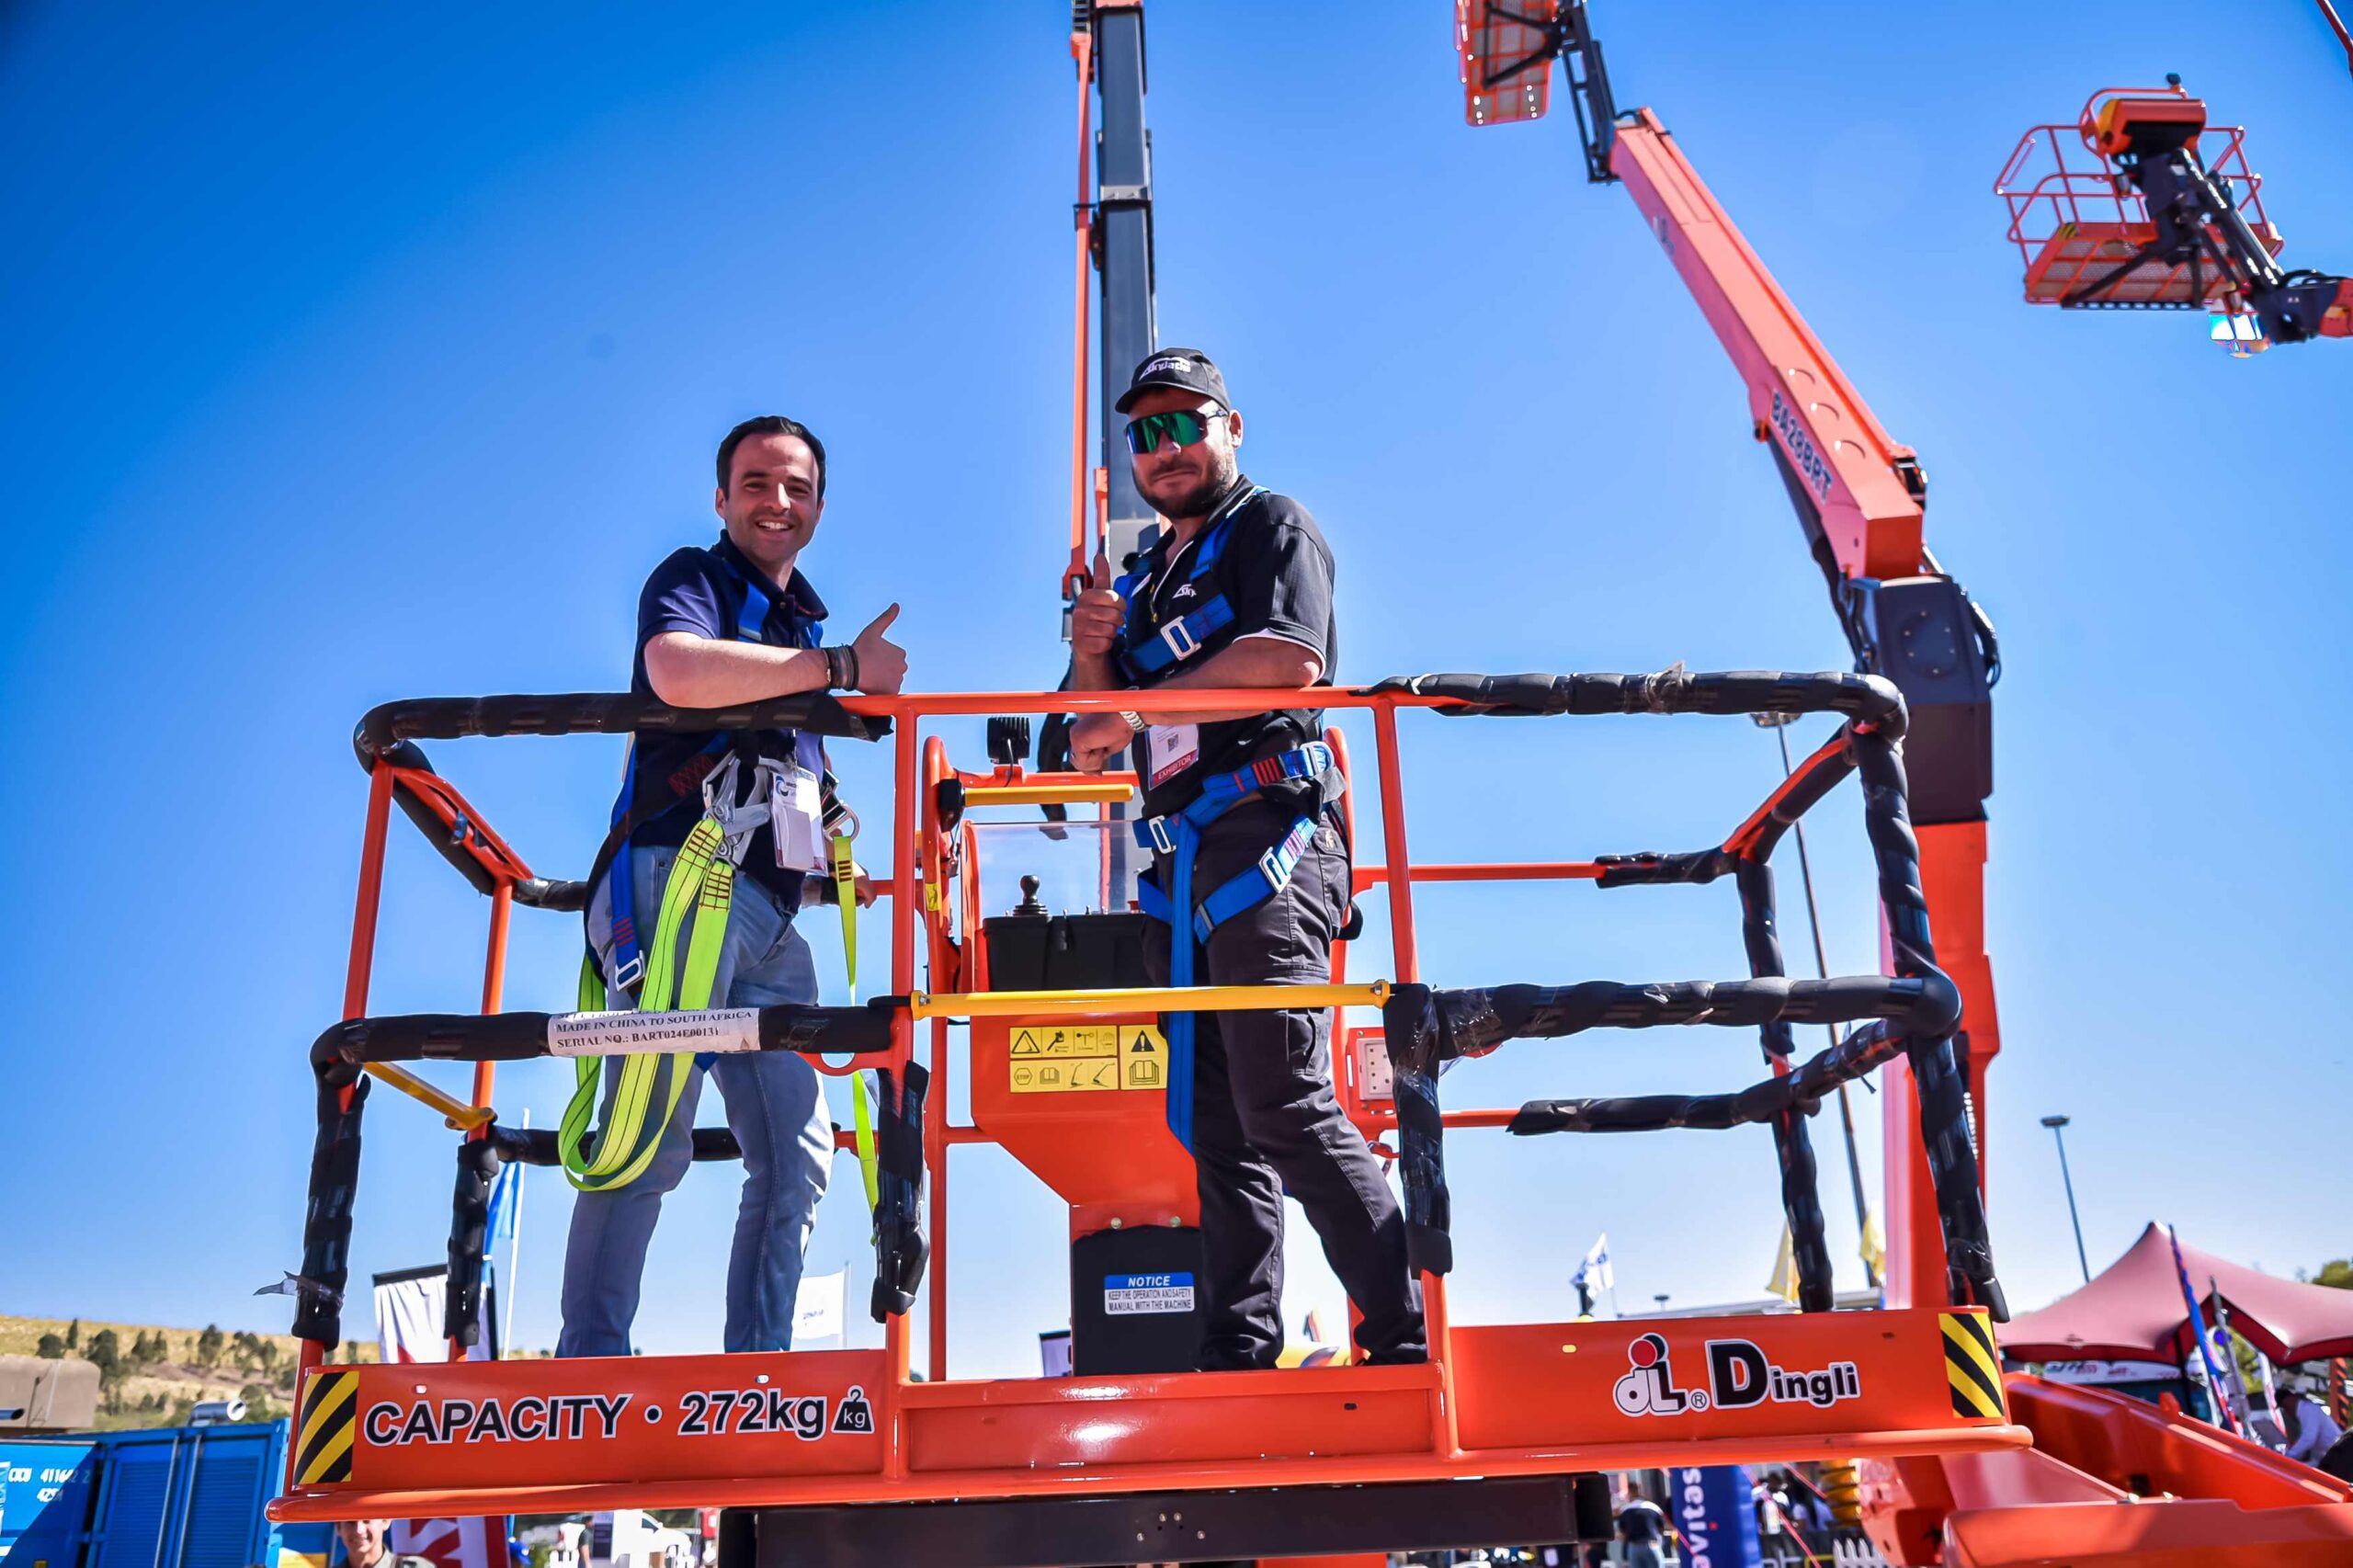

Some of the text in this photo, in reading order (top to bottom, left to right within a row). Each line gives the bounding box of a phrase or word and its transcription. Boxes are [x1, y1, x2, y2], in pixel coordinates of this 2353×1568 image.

[1158, 755, 1192, 779] EXHIBITOR
[557, 1012, 752, 1033] MADE IN CHINA TO SOUTH AFRICA
[557, 1036, 601, 1048] SERIAL
[1128, 1276, 1171, 1288] NOTICE
[1108, 1290, 1120, 1301] KEEP
[1121, 1290, 1131, 1300] THE
[1133, 1289, 1160, 1300] OPERATION
[1108, 1299, 1191, 1312] MANUAL WITH THE MACHINE
[1707, 1340, 1859, 1407] Dingli
[365, 1392, 632, 1445] CAPACITY
[678, 1390, 826, 1440] 272kg
[844, 1408, 866, 1427] kg
